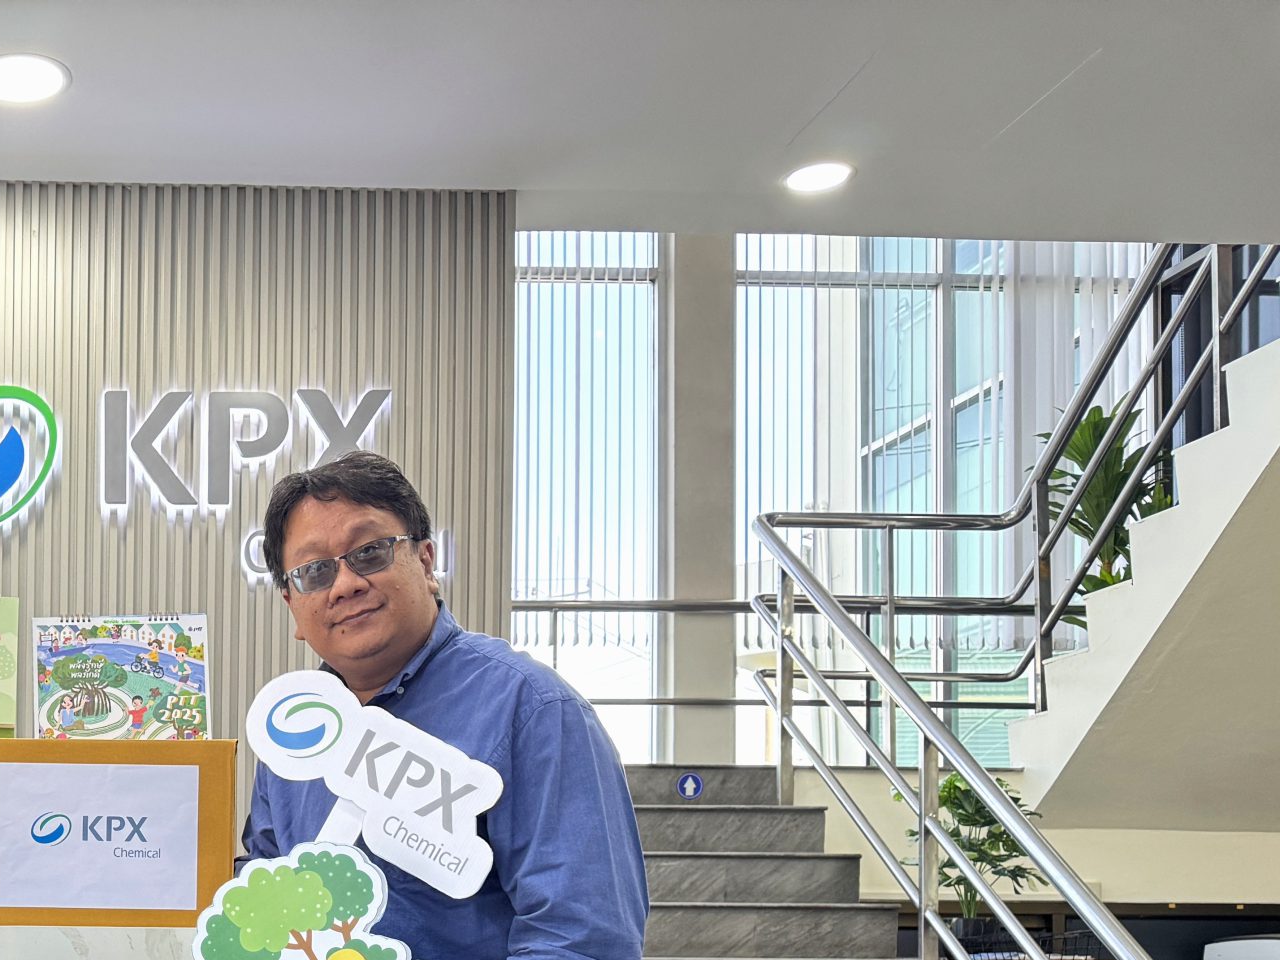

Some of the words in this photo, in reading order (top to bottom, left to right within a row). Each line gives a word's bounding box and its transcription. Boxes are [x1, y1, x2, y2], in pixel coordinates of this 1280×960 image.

[104, 389, 391, 506] KPX
[166, 695, 203, 708] PTT
[159, 708, 202, 724] 2025
[344, 728, 478, 834] KPX
[82, 815, 148, 842] KPX
[113, 847, 161, 859] Chemical
[382, 815, 469, 876] Chemical
